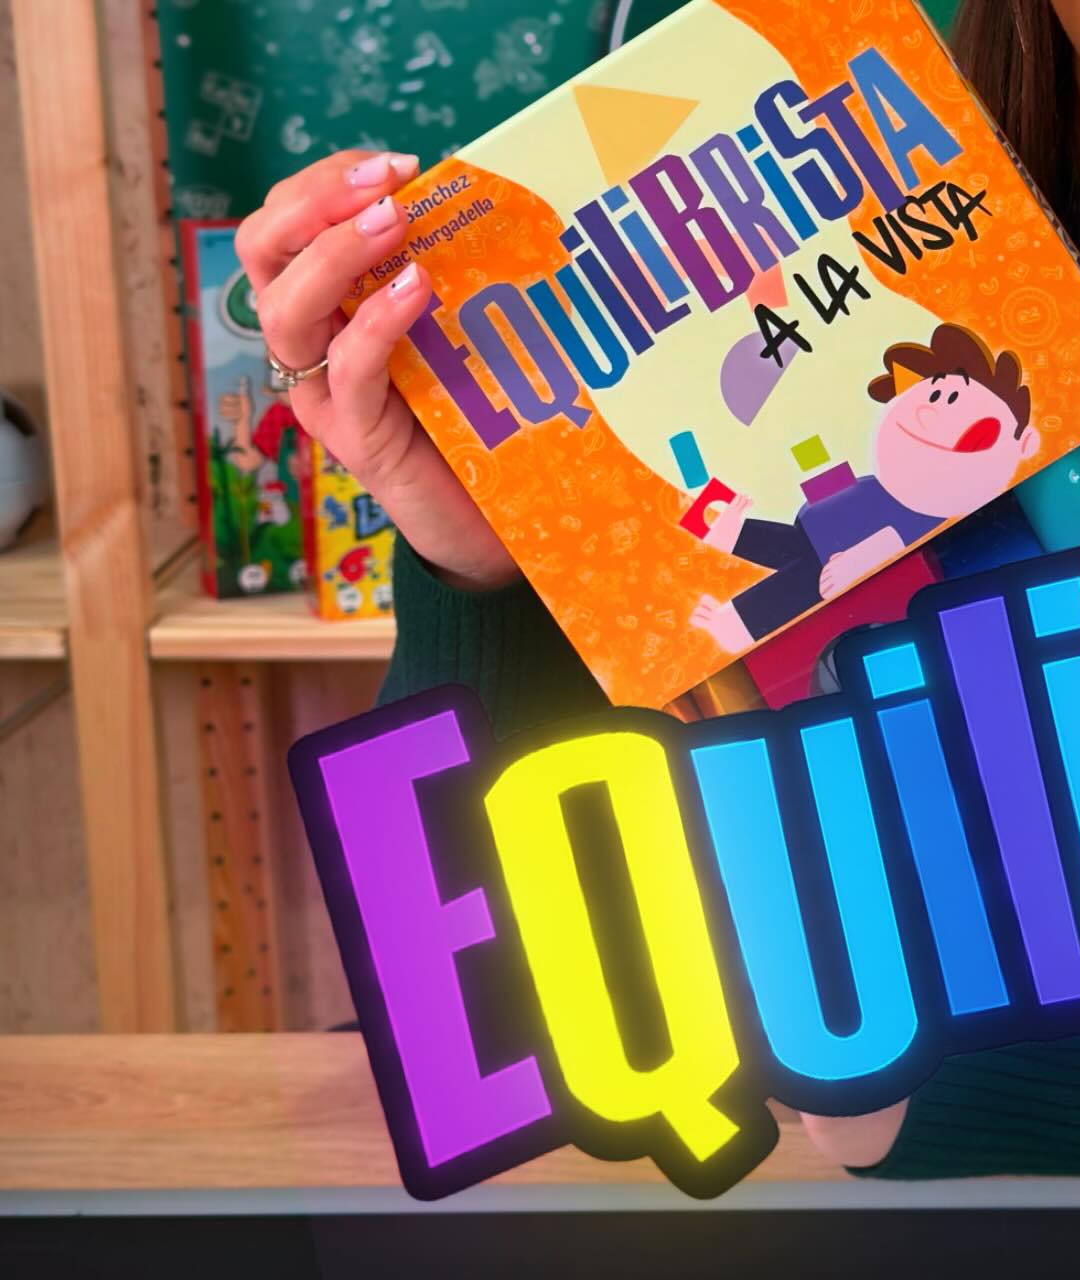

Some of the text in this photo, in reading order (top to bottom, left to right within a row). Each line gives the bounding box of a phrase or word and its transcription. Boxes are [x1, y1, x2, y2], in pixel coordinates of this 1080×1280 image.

[368, 198, 495, 281] Isaac Murgadella
[753, 181, 994, 368] A LA VISTA
